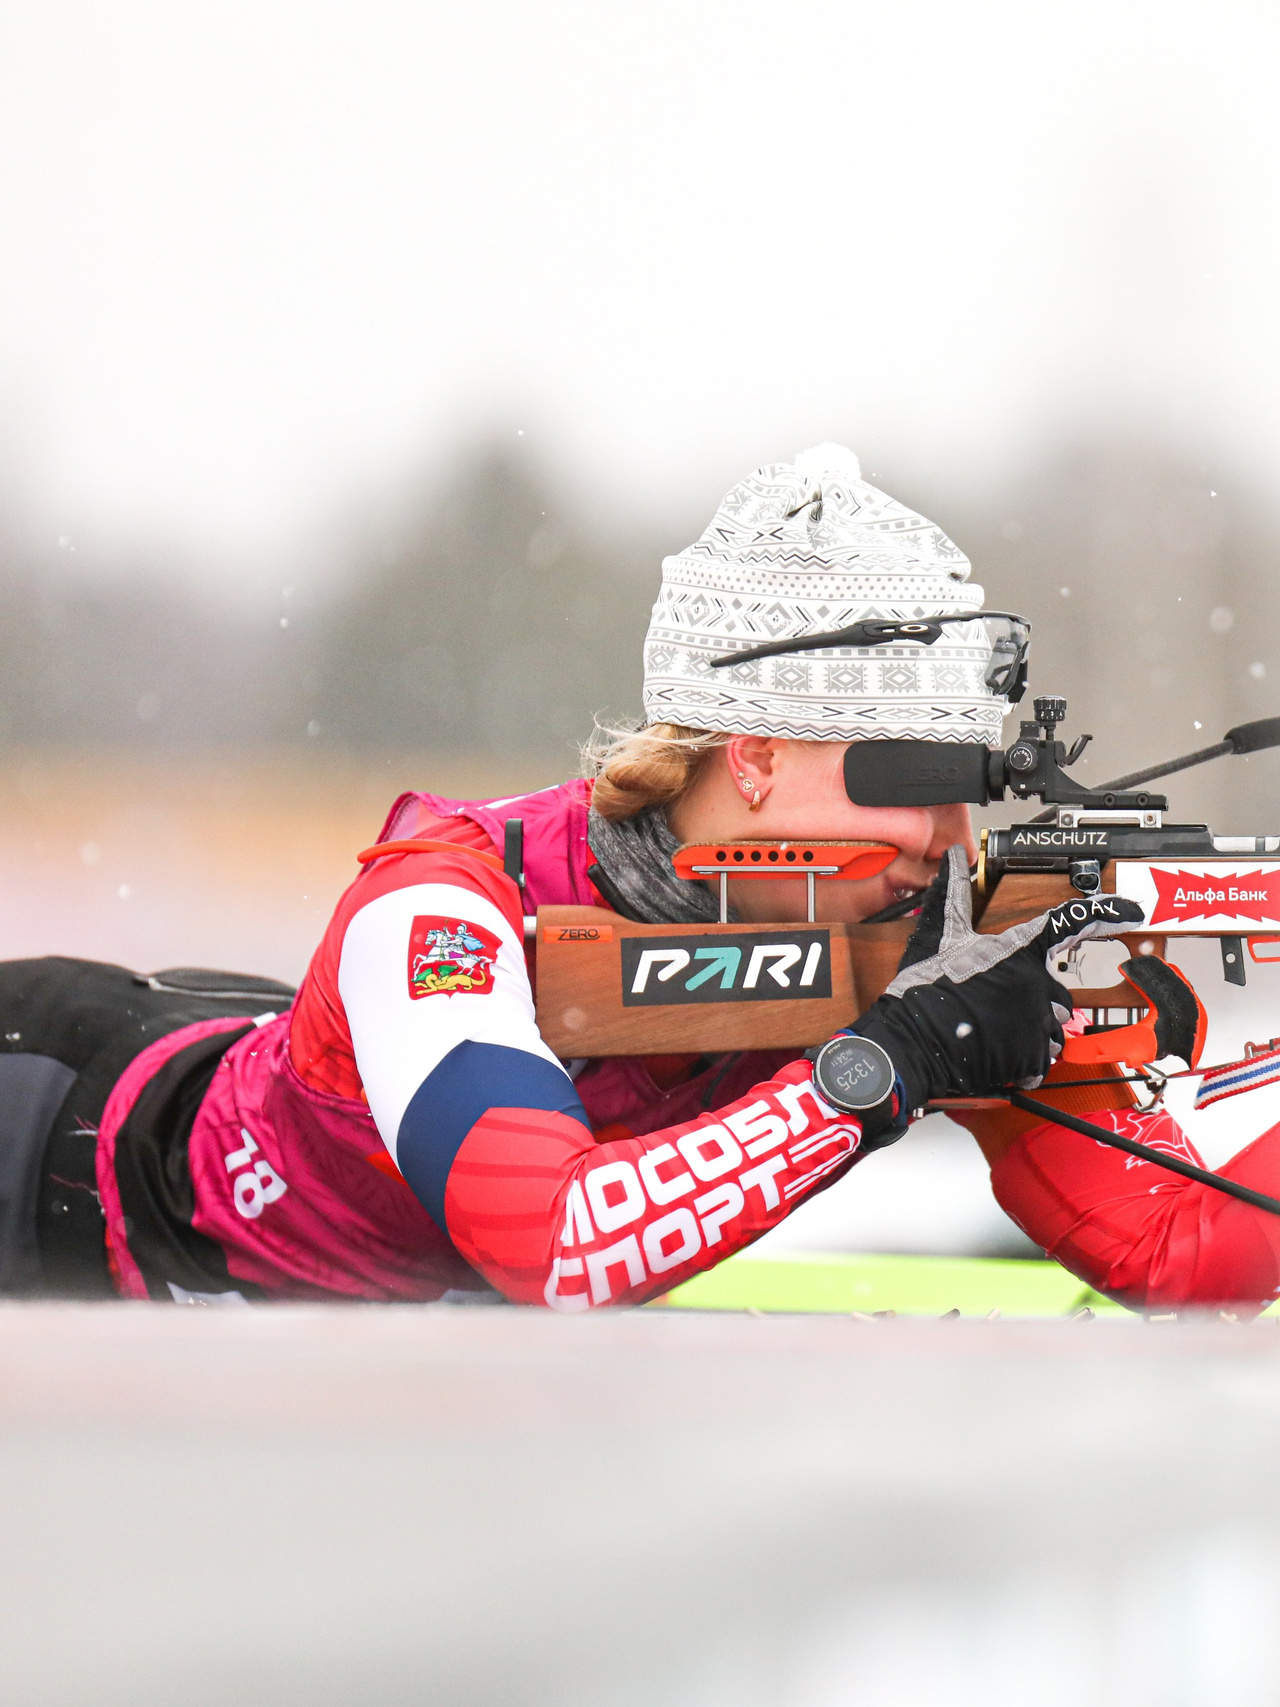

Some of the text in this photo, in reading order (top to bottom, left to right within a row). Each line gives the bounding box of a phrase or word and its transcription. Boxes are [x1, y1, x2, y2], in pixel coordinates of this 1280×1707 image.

[1013, 831, 1108, 846] ANSCHÜTZ
[1174, 887, 1268, 907] Альфа Банк
[557, 928, 601, 941] ZERO
[631, 942, 823, 993] PARI
[836, 1059, 875, 1091] 13:25
[224, 1127, 288, 1219] 18
[543, 1152, 789, 1312] СПОРТ
